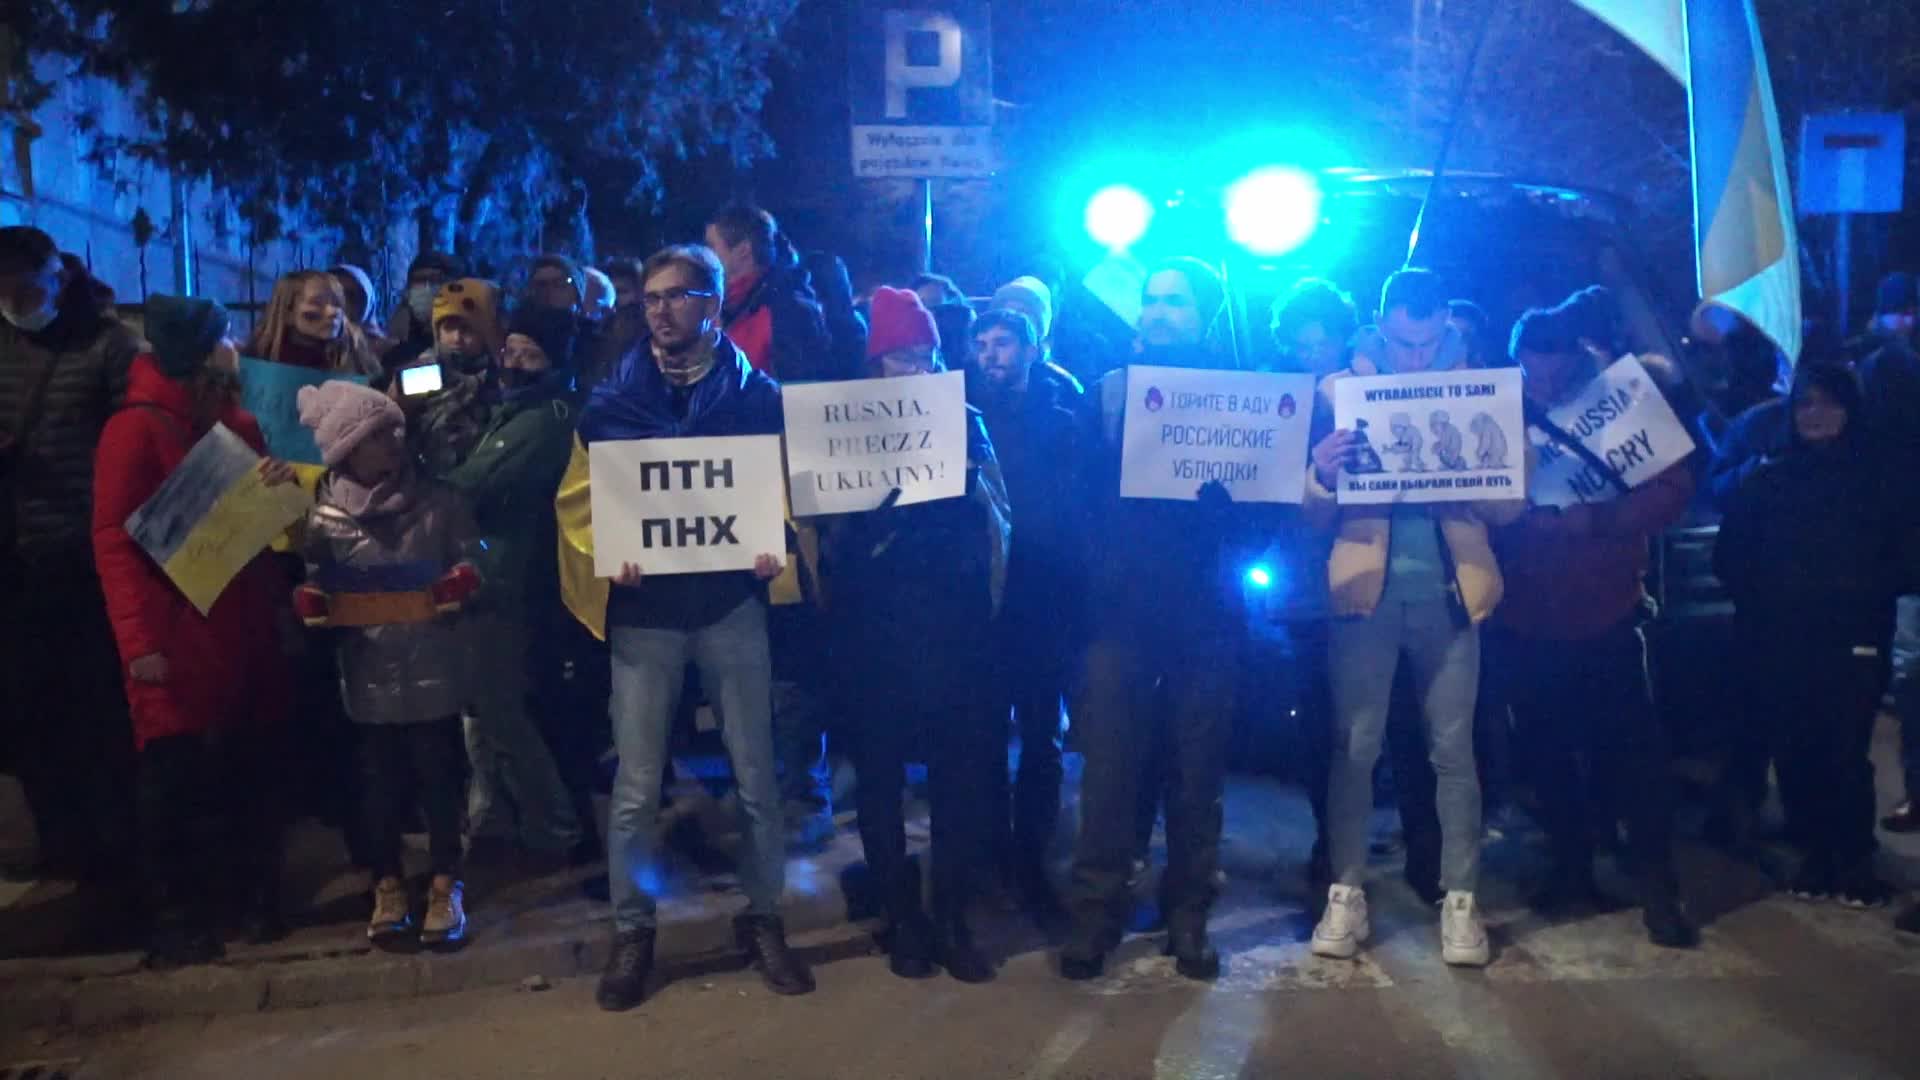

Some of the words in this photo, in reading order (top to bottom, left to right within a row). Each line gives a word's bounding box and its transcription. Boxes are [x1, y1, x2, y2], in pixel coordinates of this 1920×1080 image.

[883, 10, 962, 118] P
[1570, 387, 1632, 441] USSIA
[1161, 423, 1275, 449] РОССИЙСКИЕ
[1605, 428, 1655, 475] CRY
[640, 458, 734, 491] ПТН
[816, 460, 945, 492] UKRAINY!
[1172, 458, 1259, 482] УБЛЮДКИ
[642, 515, 740, 549] ПНХ
